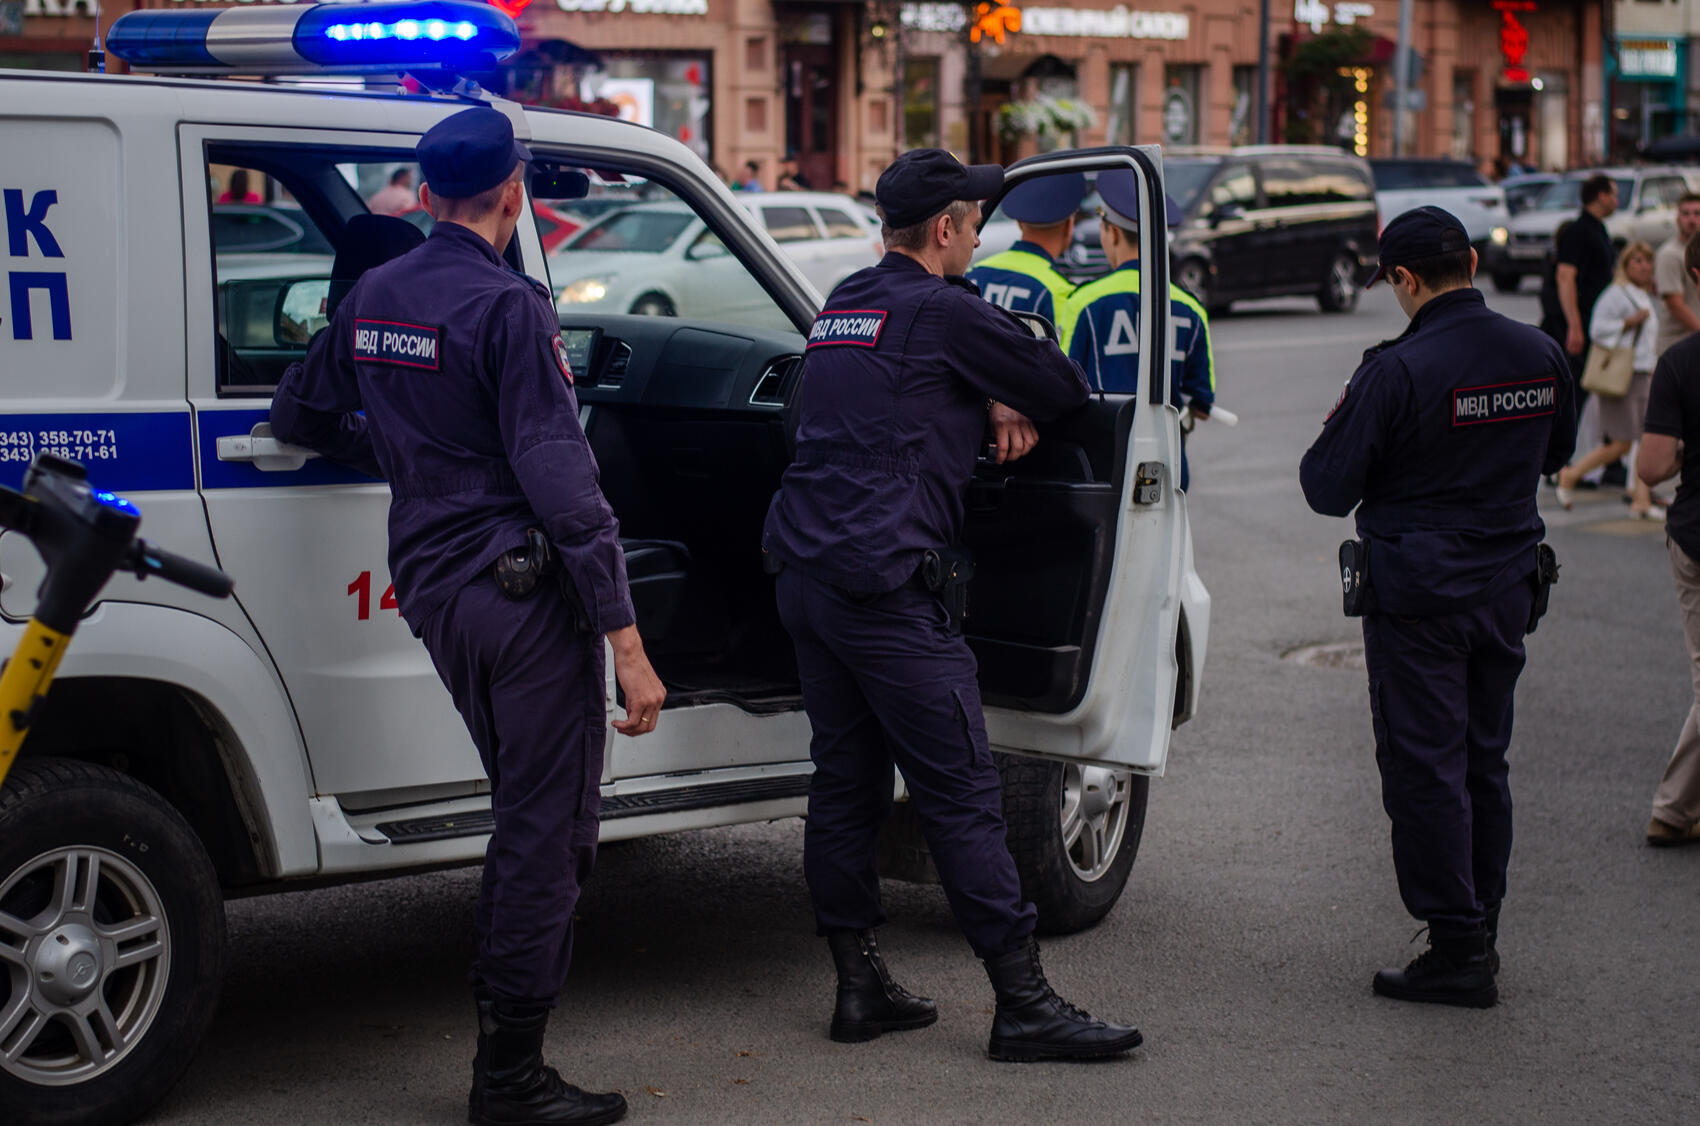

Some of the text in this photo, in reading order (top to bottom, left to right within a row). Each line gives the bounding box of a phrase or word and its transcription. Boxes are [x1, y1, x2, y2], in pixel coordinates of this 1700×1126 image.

[0, 271, 73, 341] П
[971, 279, 1031, 312] ПС
[828, 318, 882, 337] РОССИИ
[1103, 309, 1192, 362] ДС
[355, 329, 436, 359] МВД РОССИИ
[1456, 386, 1554, 417] МВД РОССИИ
[39, 430, 116, 445] 358-70-71
